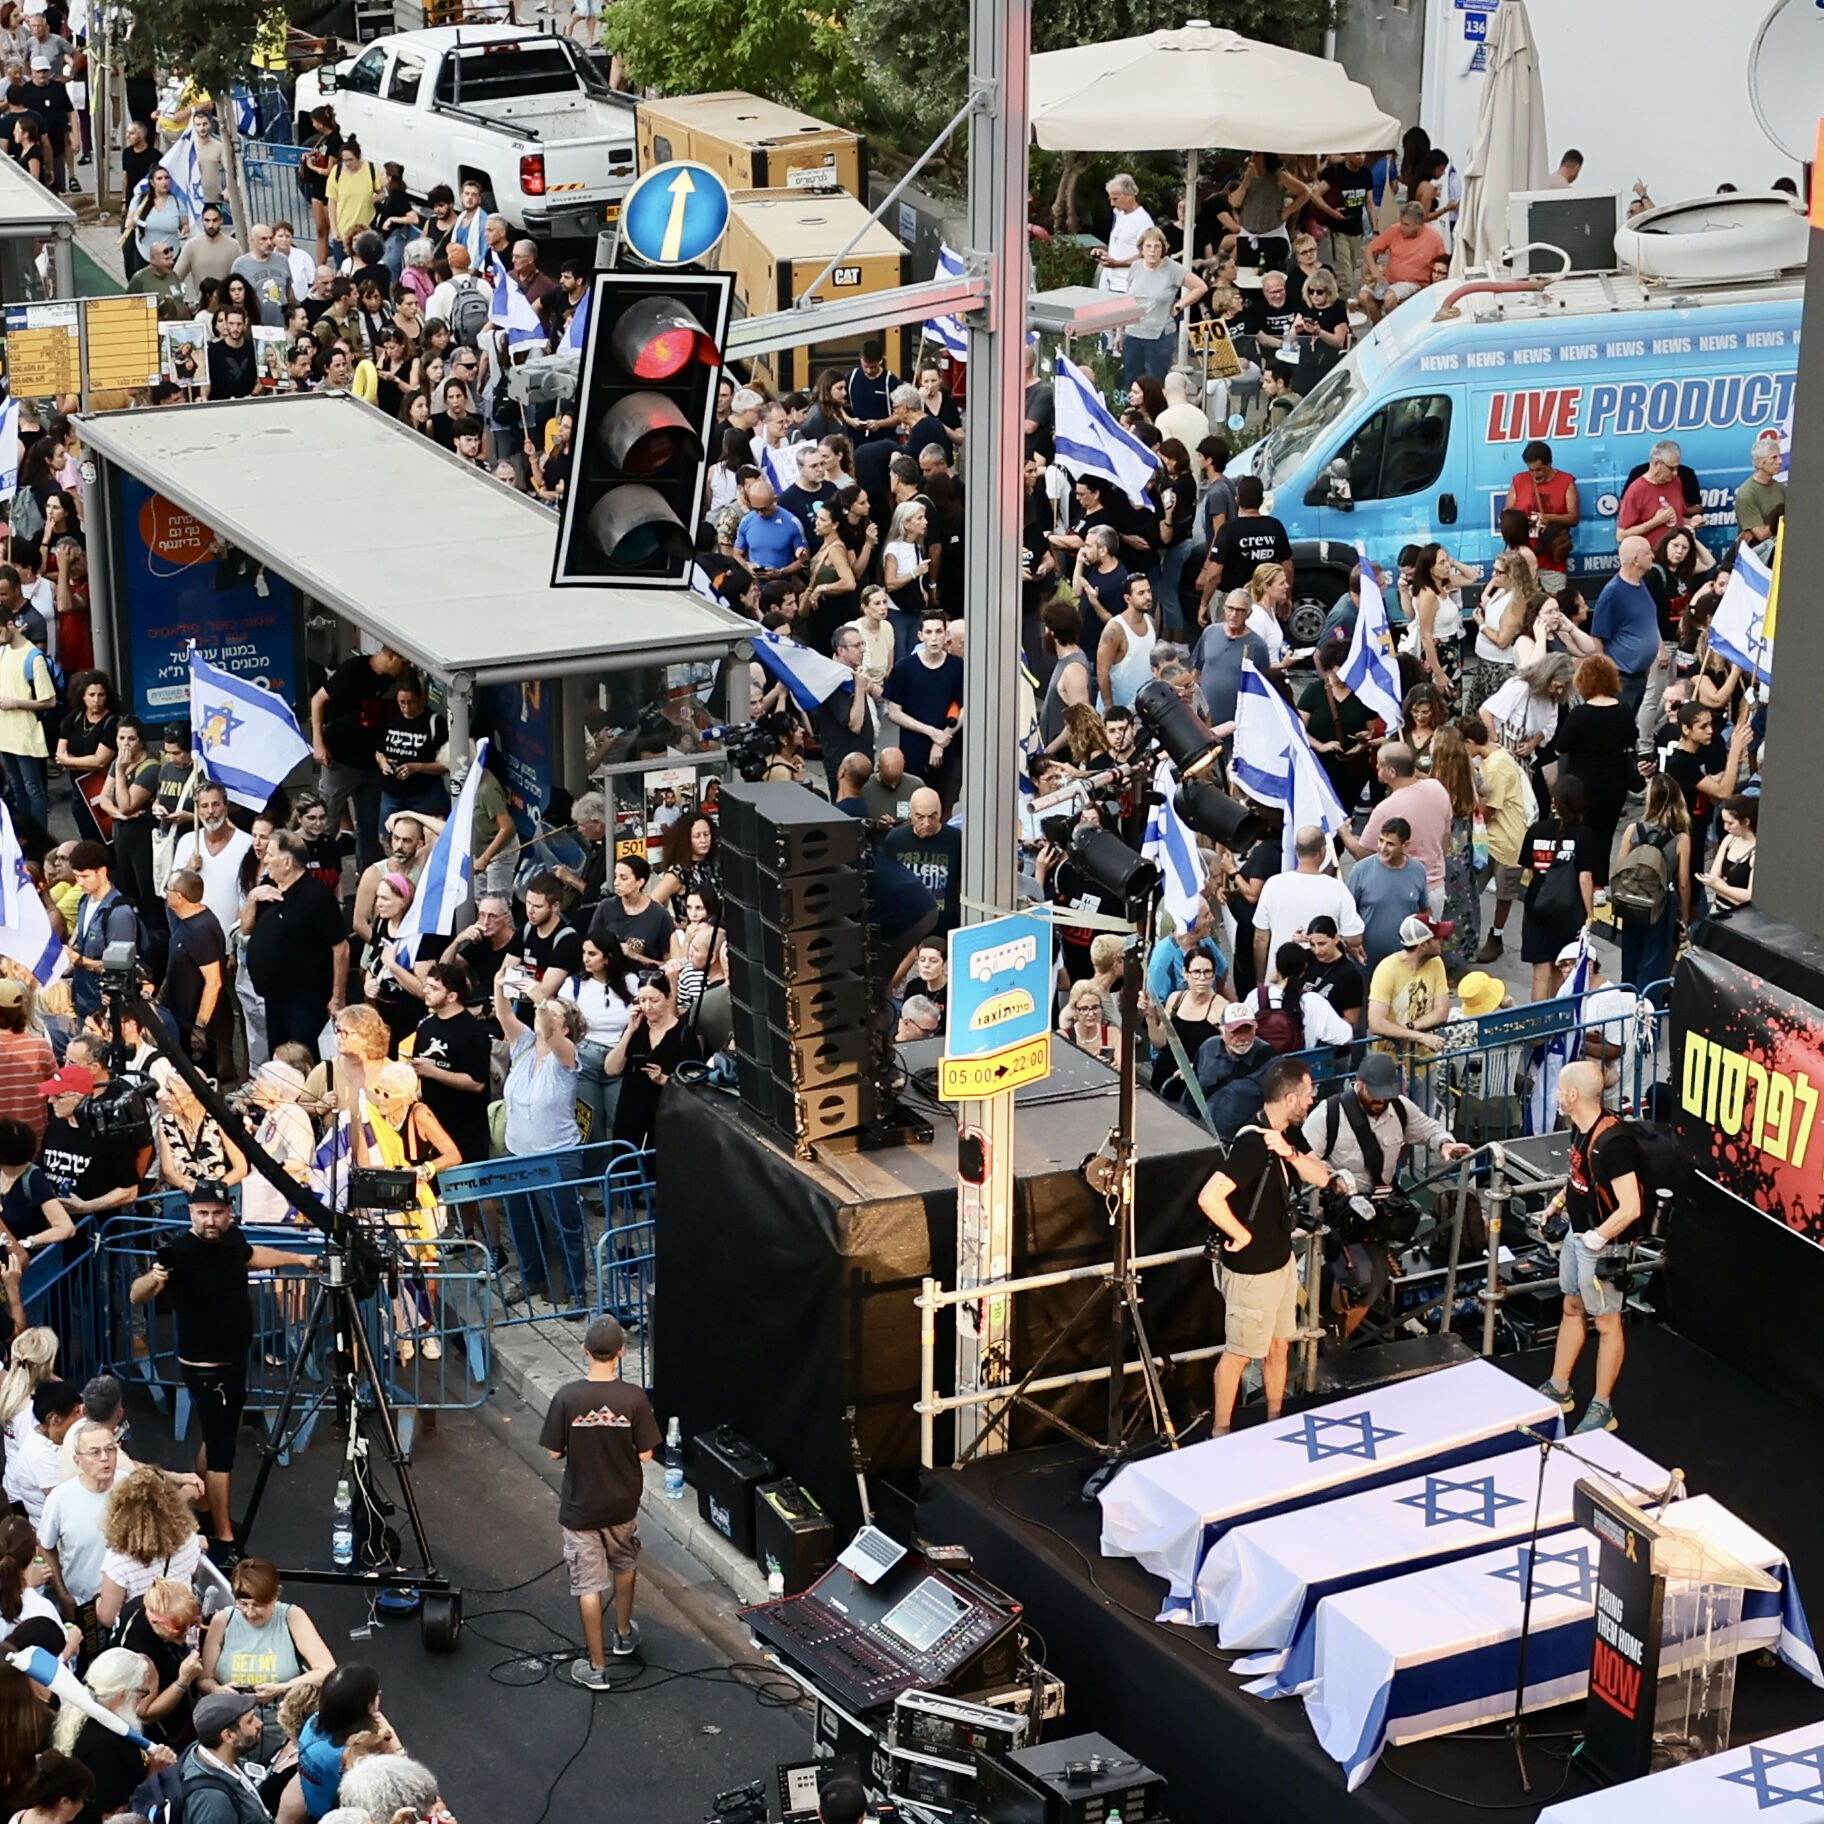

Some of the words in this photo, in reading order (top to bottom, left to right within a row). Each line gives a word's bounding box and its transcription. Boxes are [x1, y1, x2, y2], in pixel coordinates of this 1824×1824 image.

[1466, 20, 1485, 34] 136
[835, 269, 860, 286] CAT
[1421, 355, 1458, 371] NEWS
[1467, 351, 1504, 368] NEWS
[1513, 348, 1551, 364] NEWS
[1560, 345, 1597, 361] NEWS
[1606, 341, 1644, 357] NEWS
[1653, 338, 1691, 354] NEWS
[1699, 334, 1737, 351] NEWS
[1746, 331, 1784, 348] NEWS
[1486, 387, 1582, 443] LIVE
[1239, 535, 1276, 548] crew
[170, 650, 189, 664] של
[221, 644, 257, 660] במגוון
[231, 656, 270, 671] מכונים
[622, 842, 643, 856] 501
[977, 1003, 1003, 1027] taxi
[1003, 1002, 1031, 1020] מונית
[948, 1066, 992, 1086] 05:00
[1012, 1050, 1045, 1073] 22:00
[1681, 1029, 1819, 1169] לפרסום
[1597, 1583, 1624, 1624] BRING
[1596, 1608, 1618, 1648] THEM
[1617, 1625, 1644, 1666] HOME
[231, 1653, 257, 1673] GET
[1591, 1637, 1644, 1712] NOW
[917, 1697, 1005, 1725] VISION
